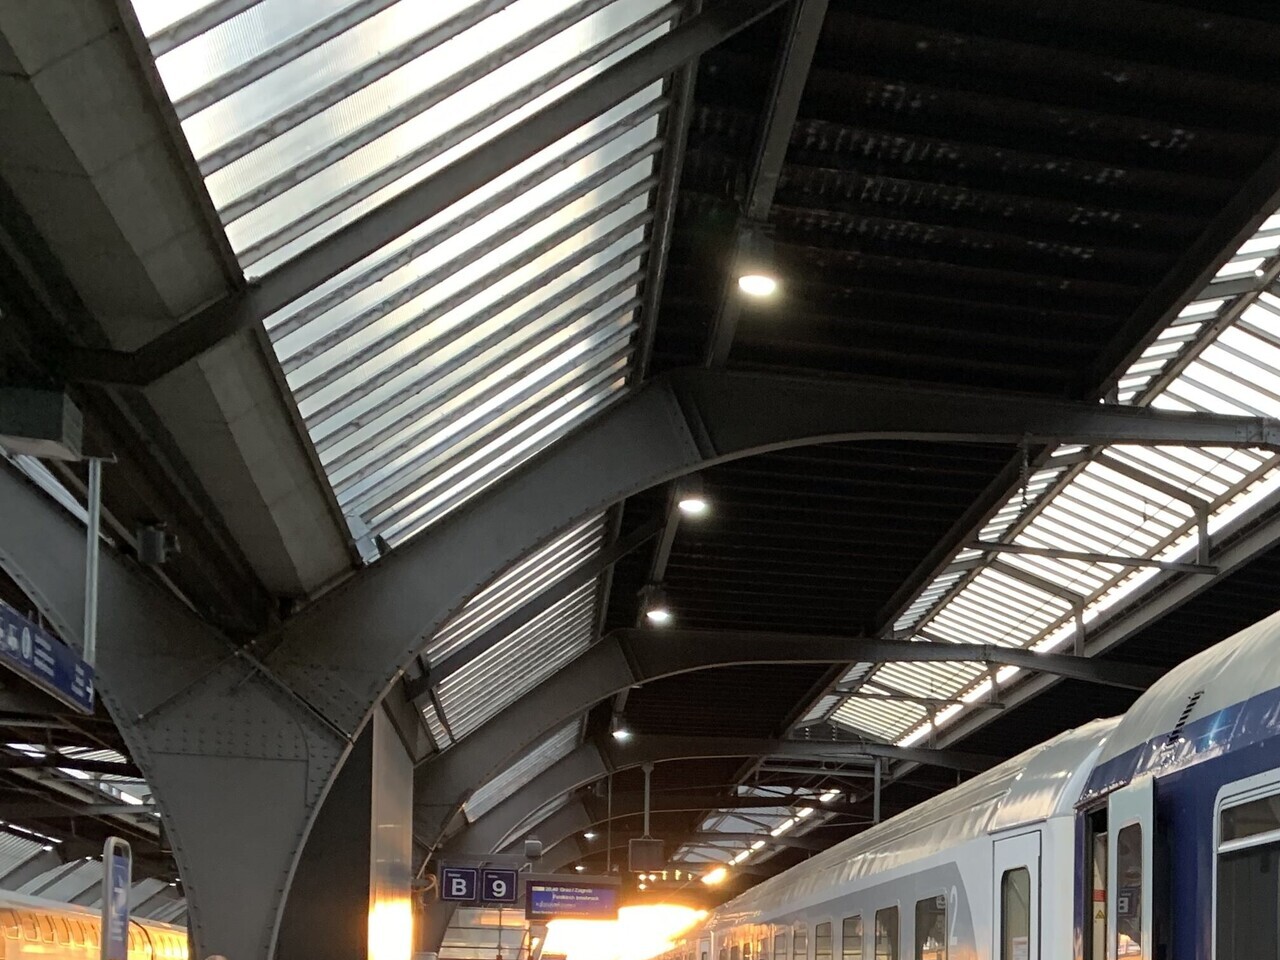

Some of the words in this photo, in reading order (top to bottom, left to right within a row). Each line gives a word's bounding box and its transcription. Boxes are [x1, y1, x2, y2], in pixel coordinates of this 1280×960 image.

[452, 878, 466, 896] B
[492, 880, 506, 897] 9
[950, 885, 958, 946] 2
